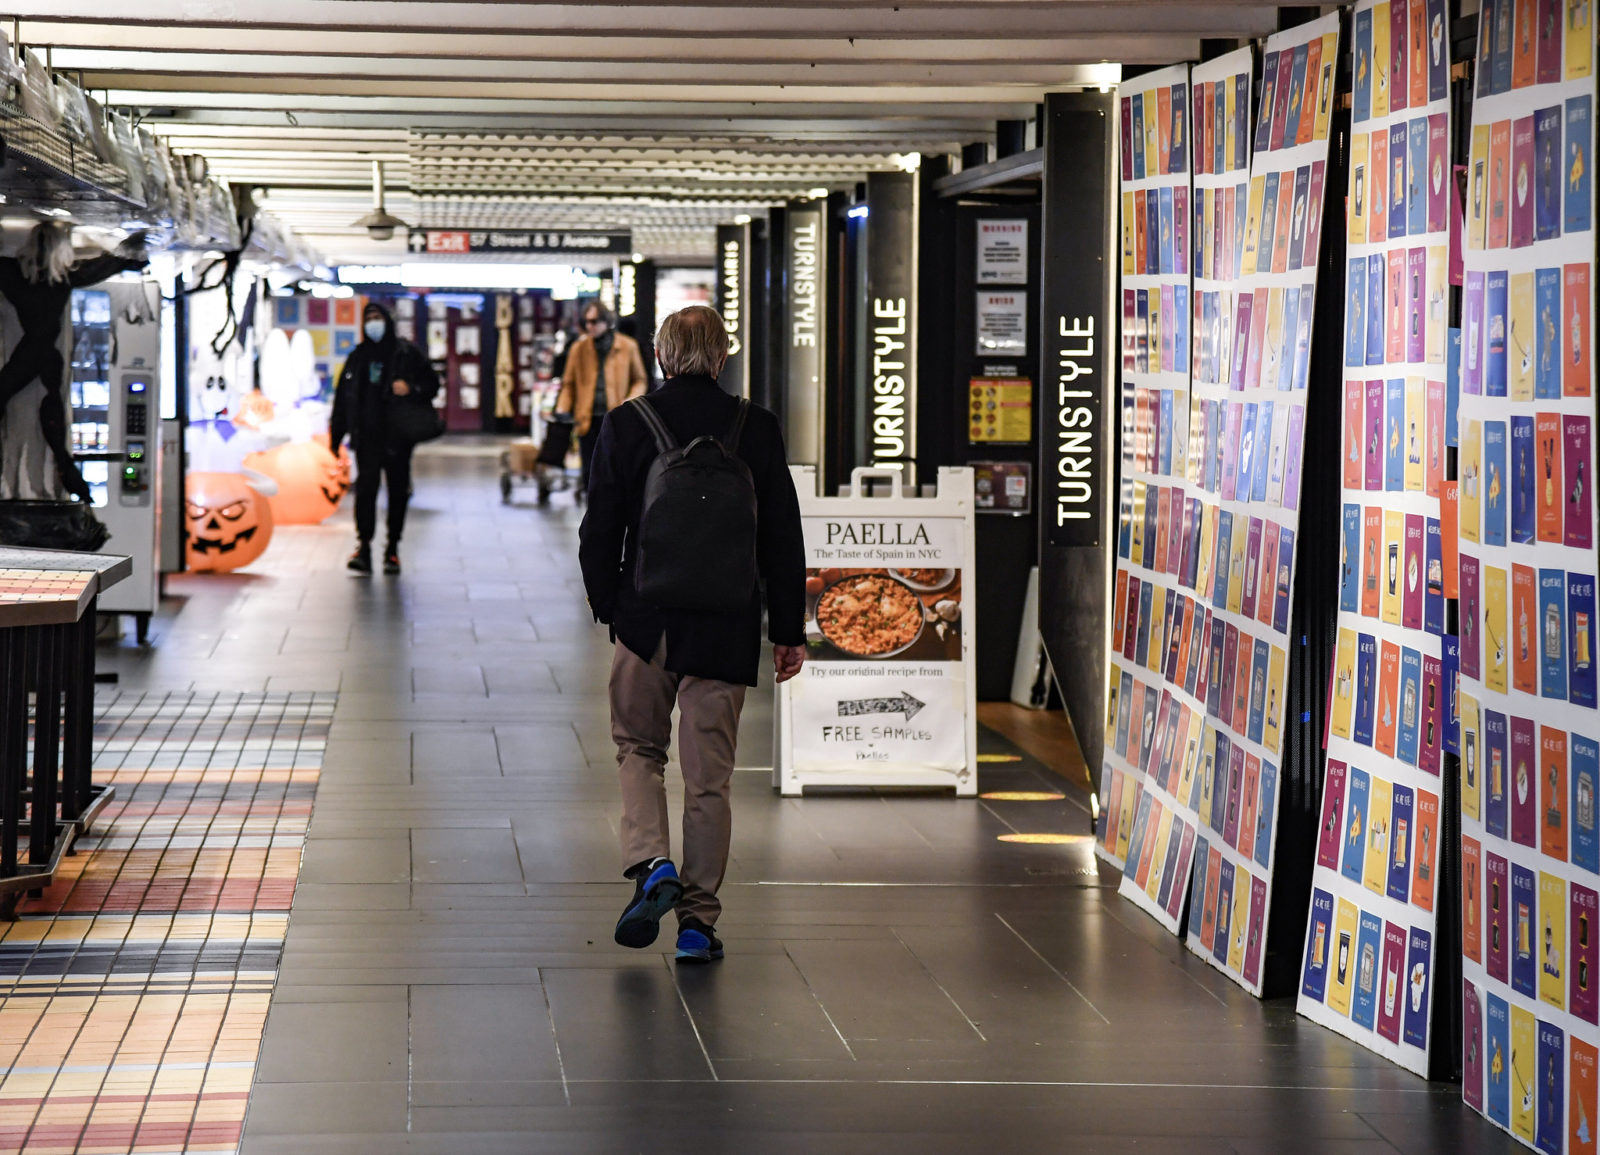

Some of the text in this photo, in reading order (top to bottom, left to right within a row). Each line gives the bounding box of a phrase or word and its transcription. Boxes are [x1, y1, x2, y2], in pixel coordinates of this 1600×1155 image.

[428, 234, 464, 251] Exit
[490, 234, 530, 247] Street
[562, 234, 610, 248] Avenue
[793, 222, 816, 347] TURNSTYLE
[1058, 315, 1094, 527] TURNSTYLE
[826, 522, 932, 545] PAELLA
[814, 549, 942, 561] The Taste of Spain in NYC
[809, 667, 943, 678] Try our original recipe from
[822, 725, 932, 742] FREE SAMPLES
